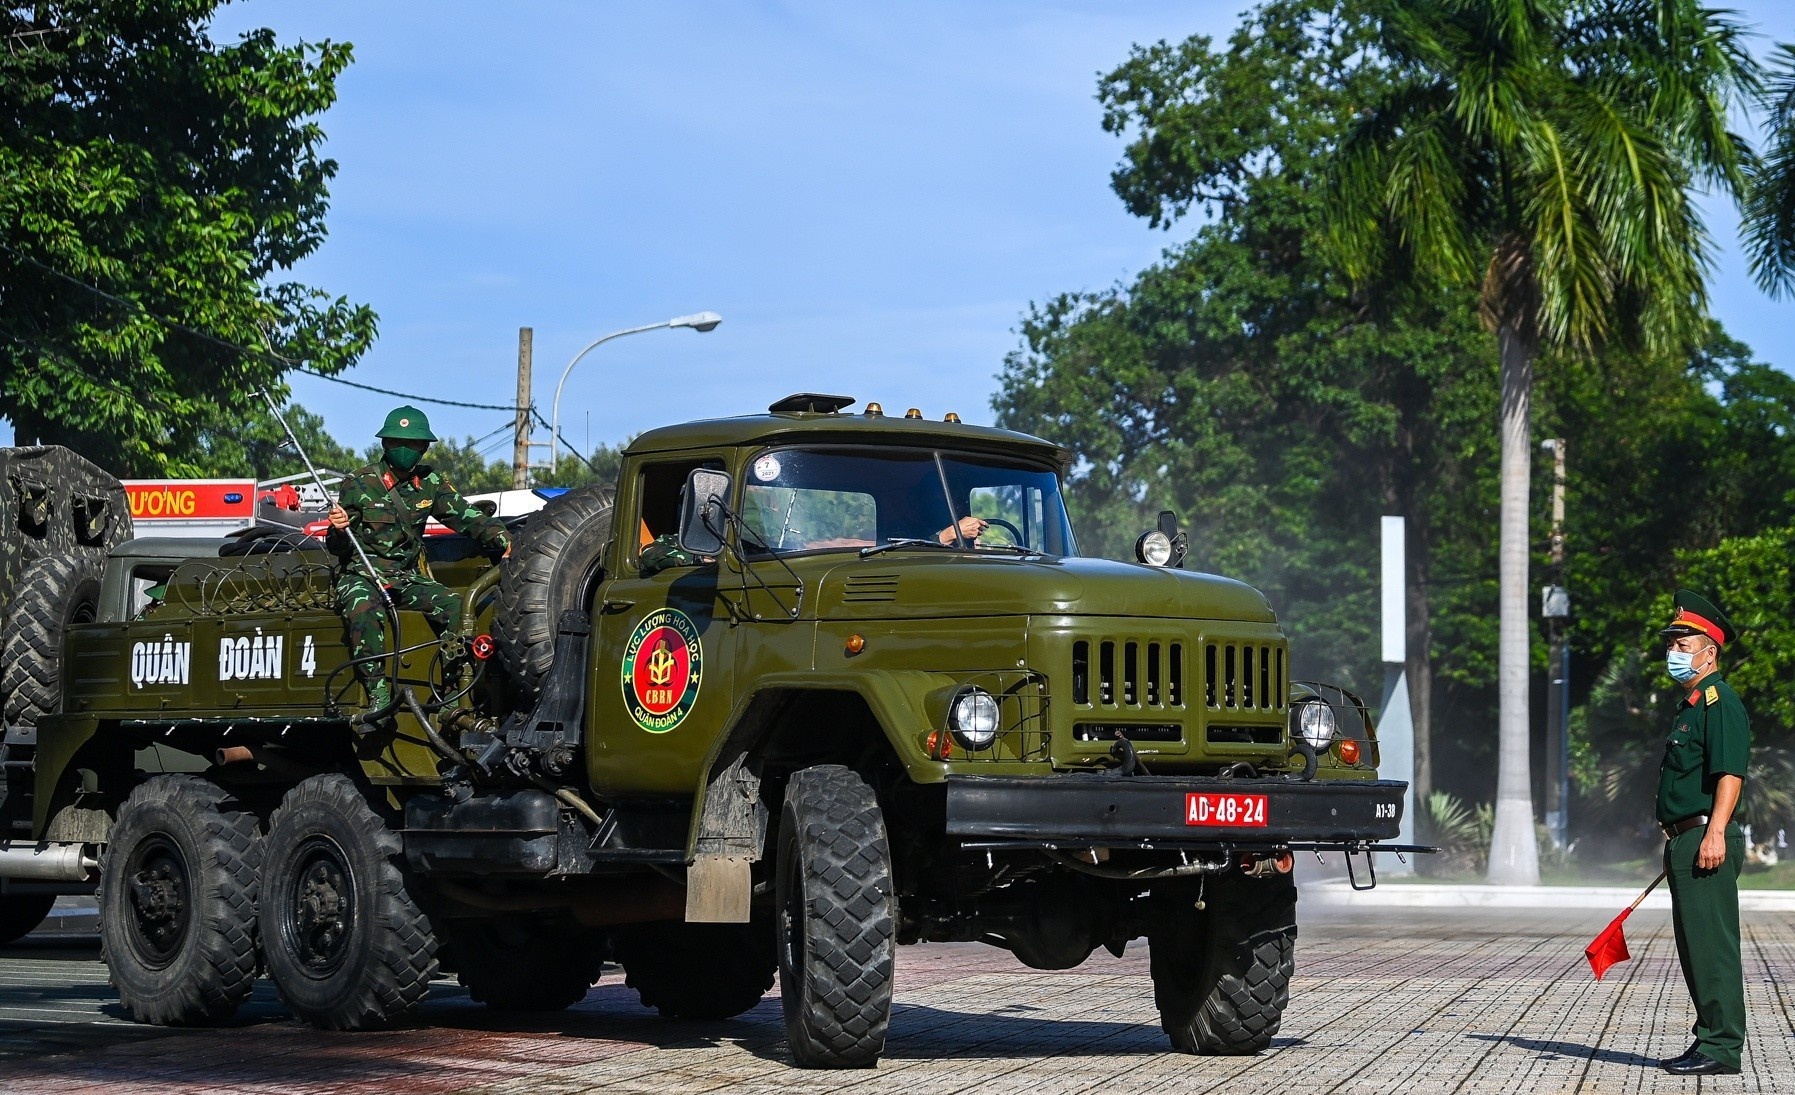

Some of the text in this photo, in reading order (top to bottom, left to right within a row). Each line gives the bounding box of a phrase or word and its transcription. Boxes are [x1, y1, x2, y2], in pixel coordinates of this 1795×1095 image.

[127, 489, 195, 515] ƯƠNG
[131, 627, 316, 689] QUÂN ĐOÀN 4
[646, 689, 673, 704] CBRN
[677, 706, 683, 716] 4
[1189, 796, 1264, 823] AD-48-24
